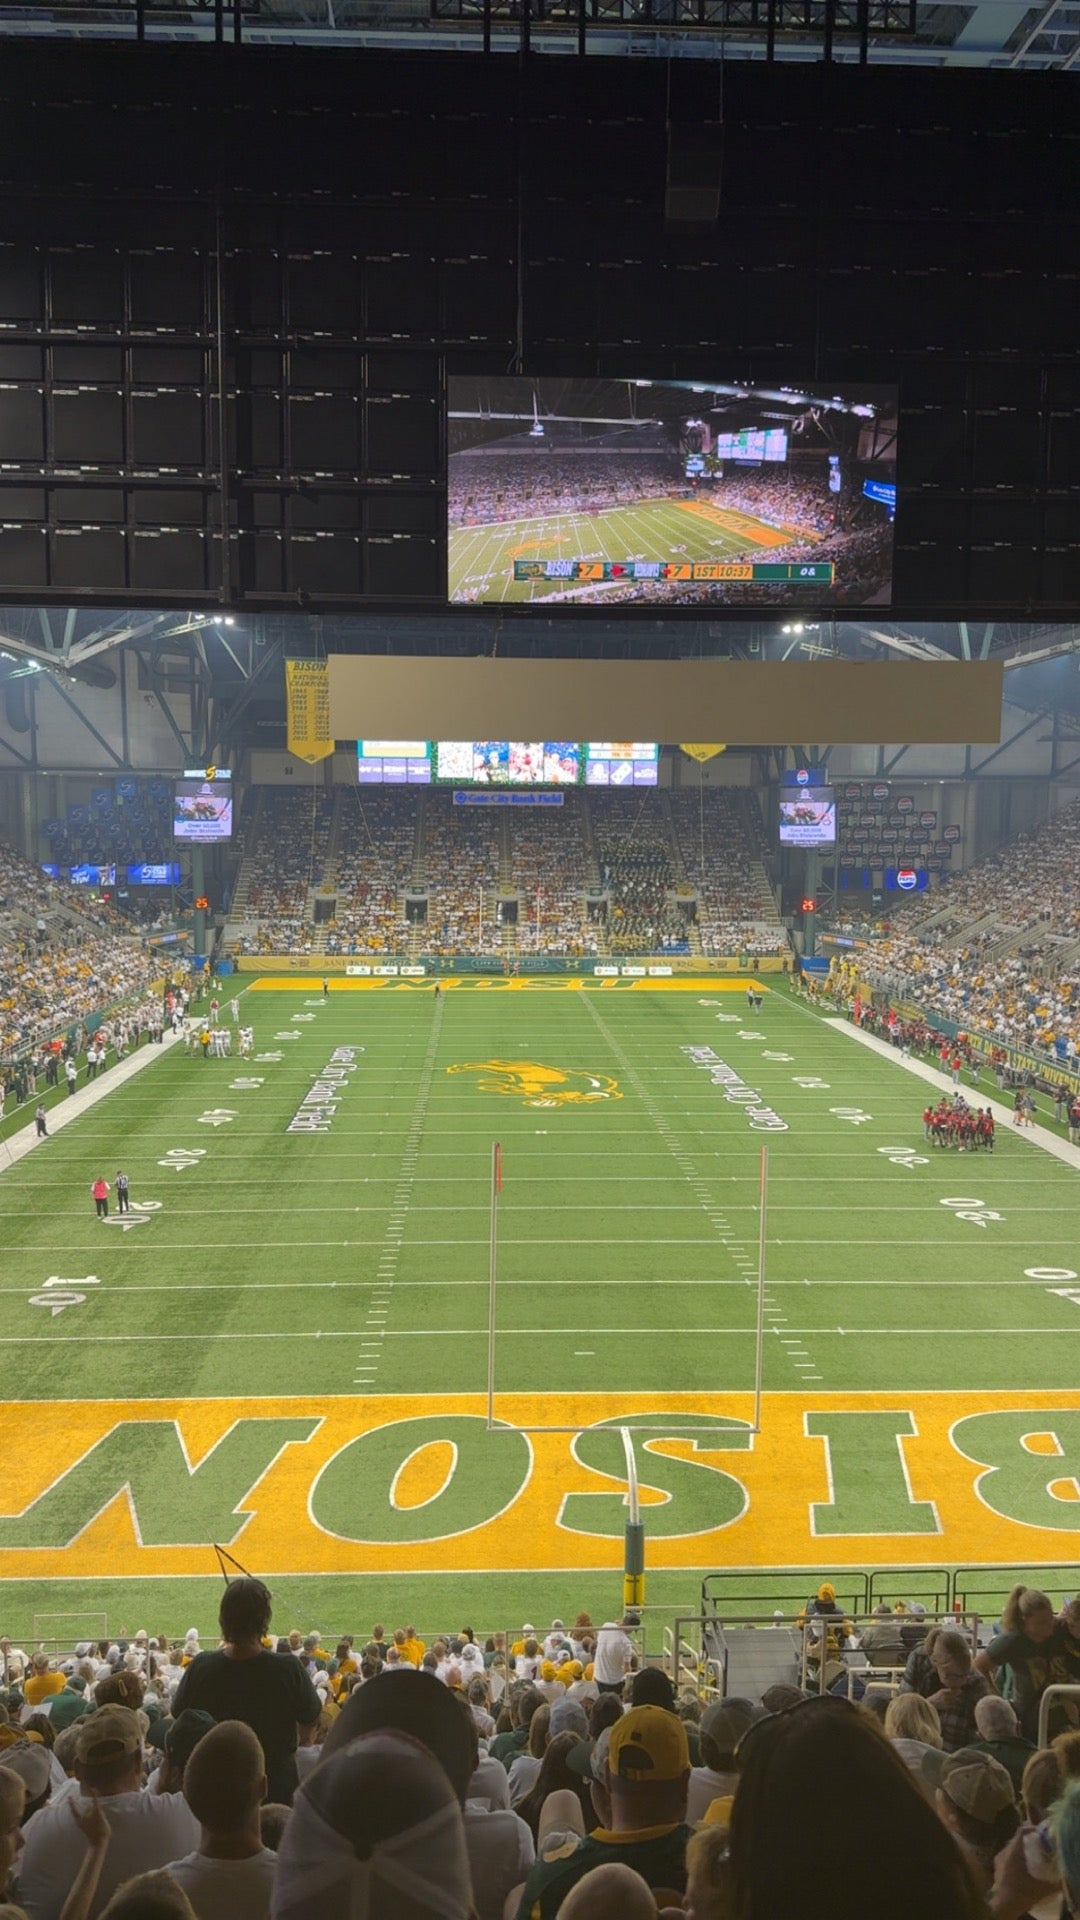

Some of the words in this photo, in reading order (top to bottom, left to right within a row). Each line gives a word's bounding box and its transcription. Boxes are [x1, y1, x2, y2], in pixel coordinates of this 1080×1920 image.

[545, 561, 573, 576] BISON
[585, 565, 594, 576] 7
[673, 566, 683, 577] 7
[696, 566, 716, 577] 1ST
[719, 566, 751, 577] 10:37
[293, 662, 327, 671] BISON
[468, 794, 488, 803] Gate
[491, 794, 508, 804] City
[512, 794, 535, 803] Bank
[539, 794, 562, 803] Field
[196, 897, 208, 909] 25
[802, 899, 814, 911] 25
[374, 978, 638, 990] NDSU
[286, 1105, 337, 1132] Field
[157, 1148, 207, 1167] 30
[876, 1146, 930, 1164] 30
[102, 1201, 163, 1225] 20
[939, 1197, 1006, 1221] 20
[28, 1275, 101, 1307] 10
[0, 1408, 1080, 1548] BISON
